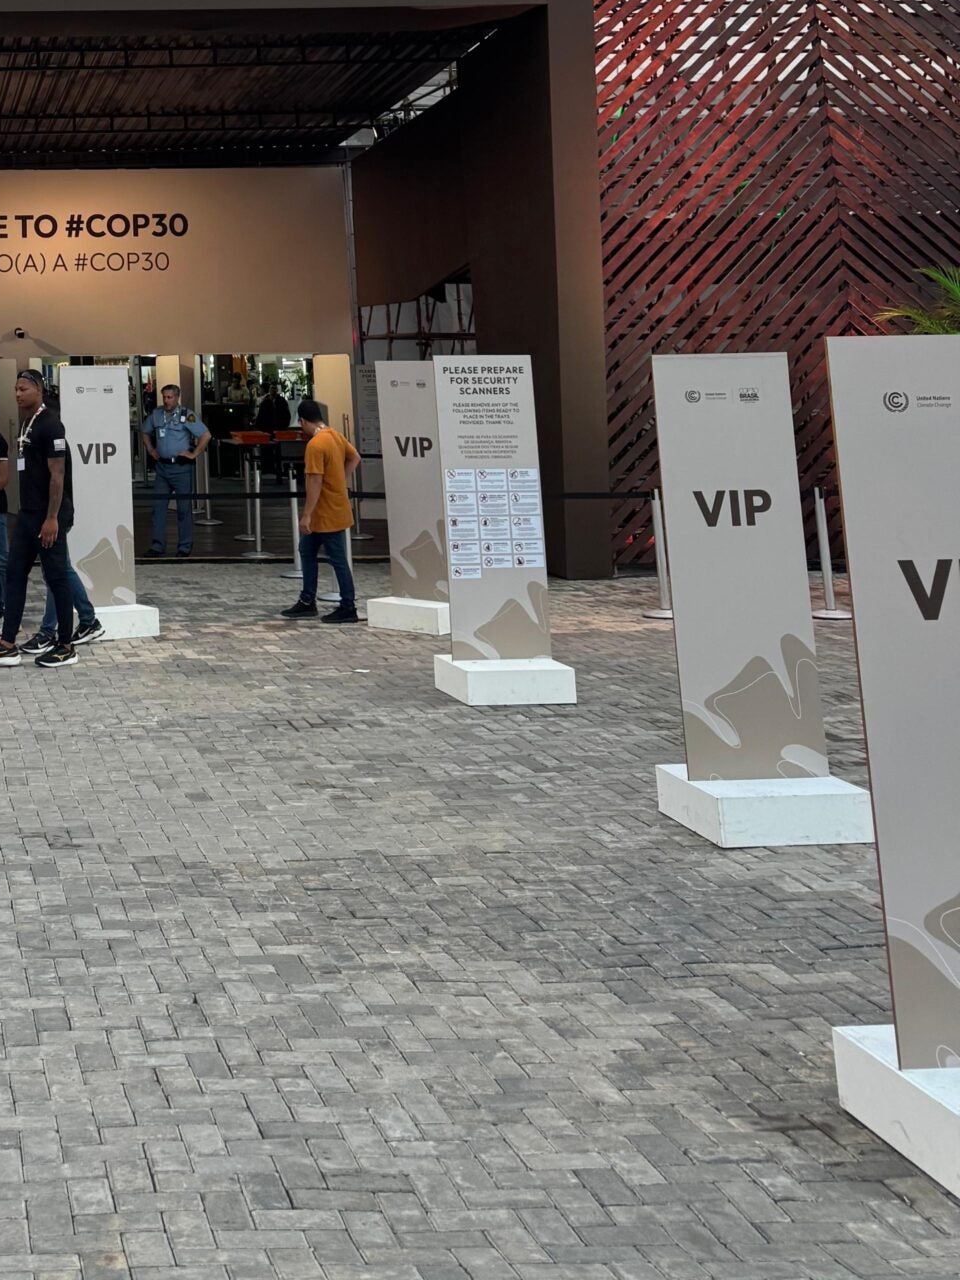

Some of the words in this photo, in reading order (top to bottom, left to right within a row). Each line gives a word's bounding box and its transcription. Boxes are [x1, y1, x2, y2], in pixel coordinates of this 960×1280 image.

[15, 214, 58, 239] TO
[65, 213, 189, 238] #COP30
[52, 254, 69, 272] A
[74, 251, 170, 272] #COP30
[442, 366, 479, 374] PLEASE
[481, 366, 525, 374] PREPARE
[450, 377, 470, 385] FOR
[471, 377, 519, 385] SECURITY
[459, 387, 511, 395] SCANNERS
[77, 442, 117, 465] VIP
[394, 435, 433, 458] VIP
[692, 488, 772, 528] VIP
[897, 558, 960, 621] V
